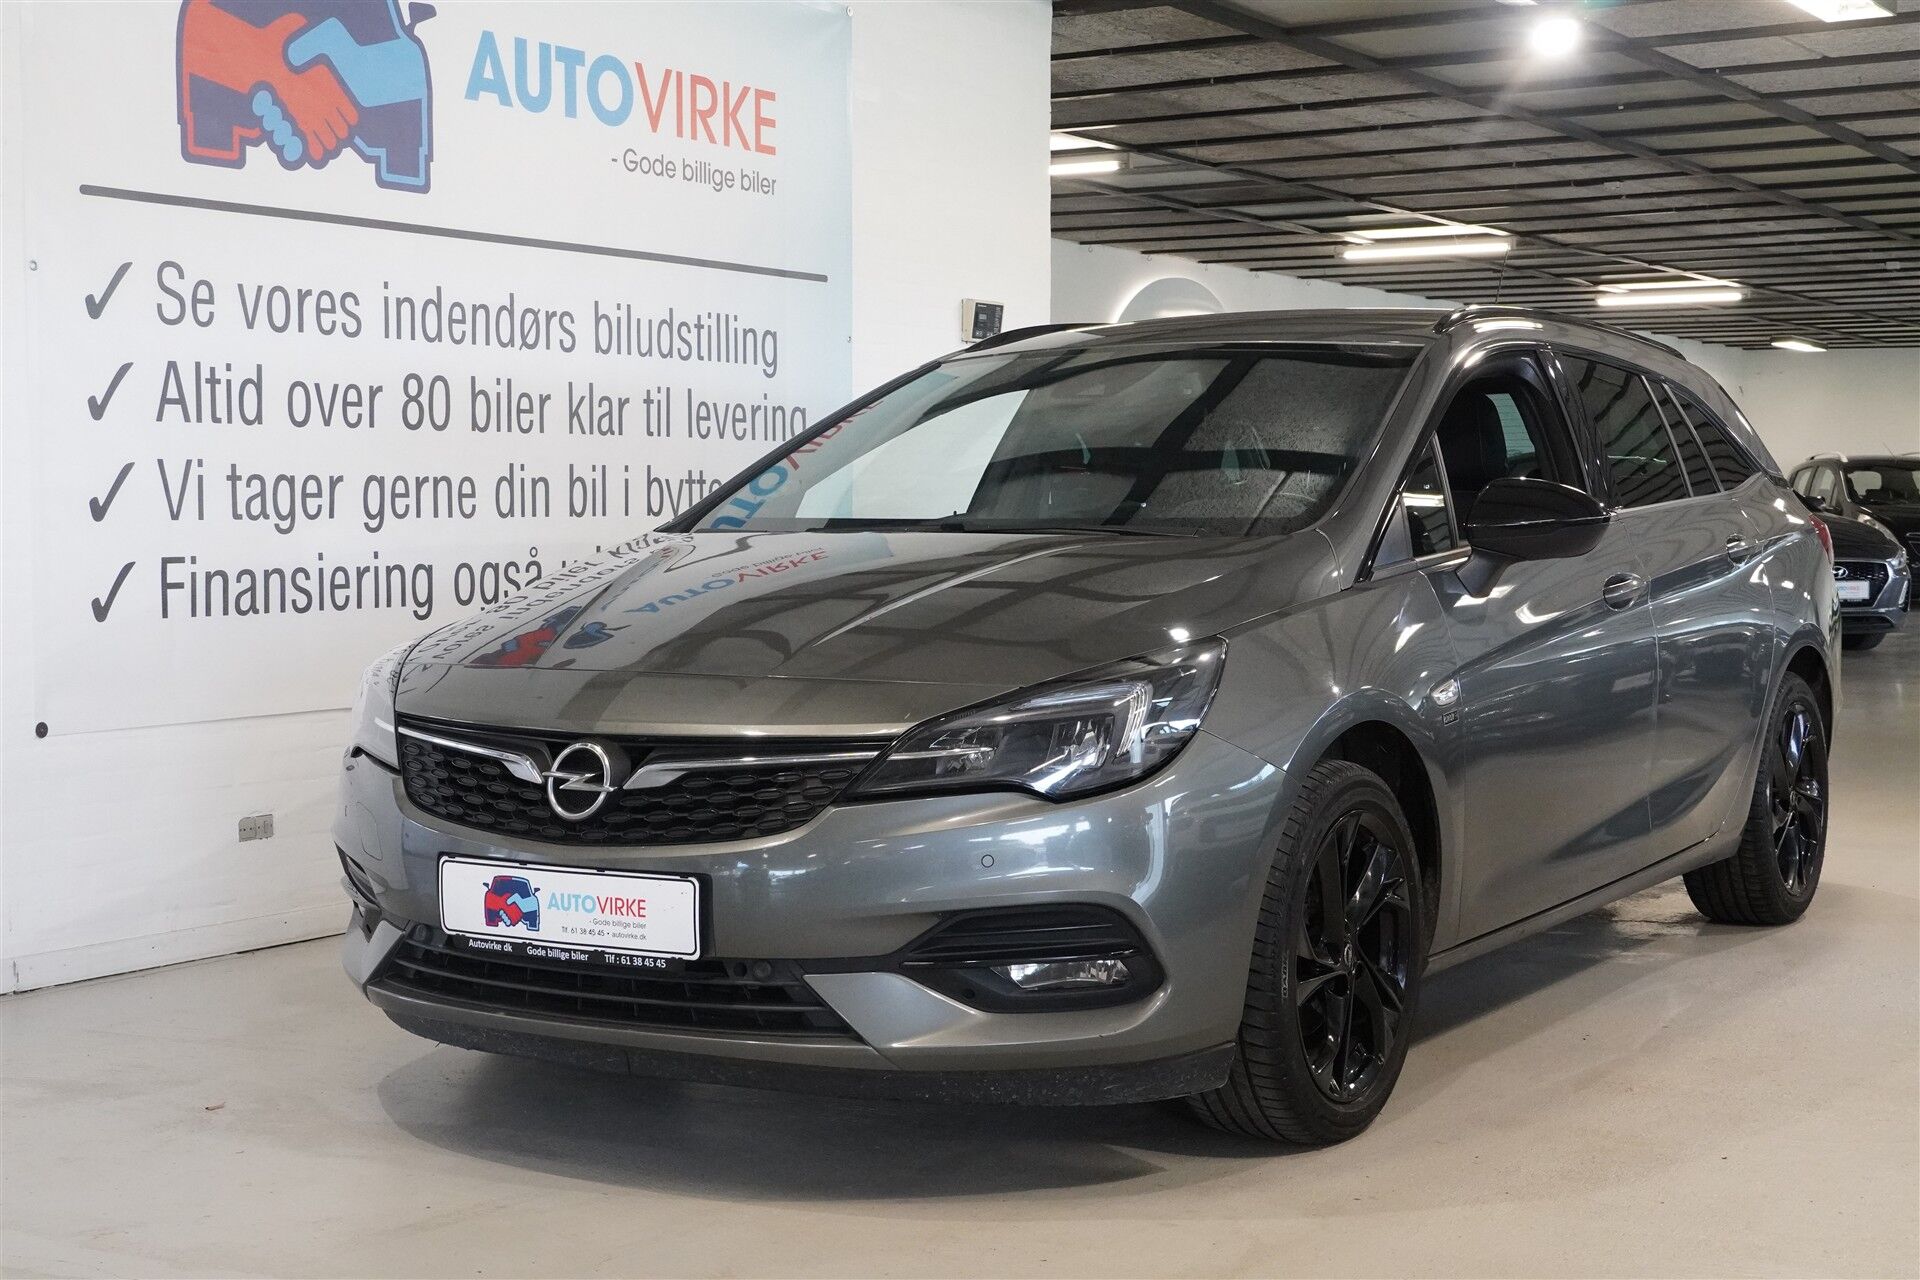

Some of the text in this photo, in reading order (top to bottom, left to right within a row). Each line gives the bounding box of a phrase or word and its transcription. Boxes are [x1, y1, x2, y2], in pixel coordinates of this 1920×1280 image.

[464, 30, 776, 156] AUTOVIRKE
[623, 148, 676, 178] Gode
[682, 158, 735, 192] billige
[740, 168, 777, 196] biler
[156, 260, 778, 378] Se vores indendørs biludstilling
[156, 360, 263, 426] Altid
[287, 380, 383, 429] over
[401, 373, 451, 431] 80
[471, 376, 552, 434] biler
[568, 381, 630, 436] klar
[643, 386, 671, 437] til
[157, 458, 204, 521] Vi
[226, 463, 344, 534] tager
[363, 474, 477, 533] gerne
[495, 463, 550, 518] din
[569, 463, 607, 518] bil
[624, 464, 629, 517] i
[161, 550, 434, 620] Finansiering
[547, 892, 646, 918] AUTOVIRKE
[580, 927, 587, 935] 38
[597, 929, 605, 937] 45
[593, 917, 610, 926] Gode
[612, 919, 631, 930] billige
[632, 921, 647, 930] biler
[469, 939, 501, 951] Autovirke
[503, 943, 513, 952] dk
[527, 946, 546, 958] Gode
[548, 949, 570, 961] billige
[572, 952, 589, 962] biler
[621, 956, 631, 965] 61
[633, 957, 643, 966] 38
[644, 958, 655, 967] 45
[656, 959, 667, 969] 45
